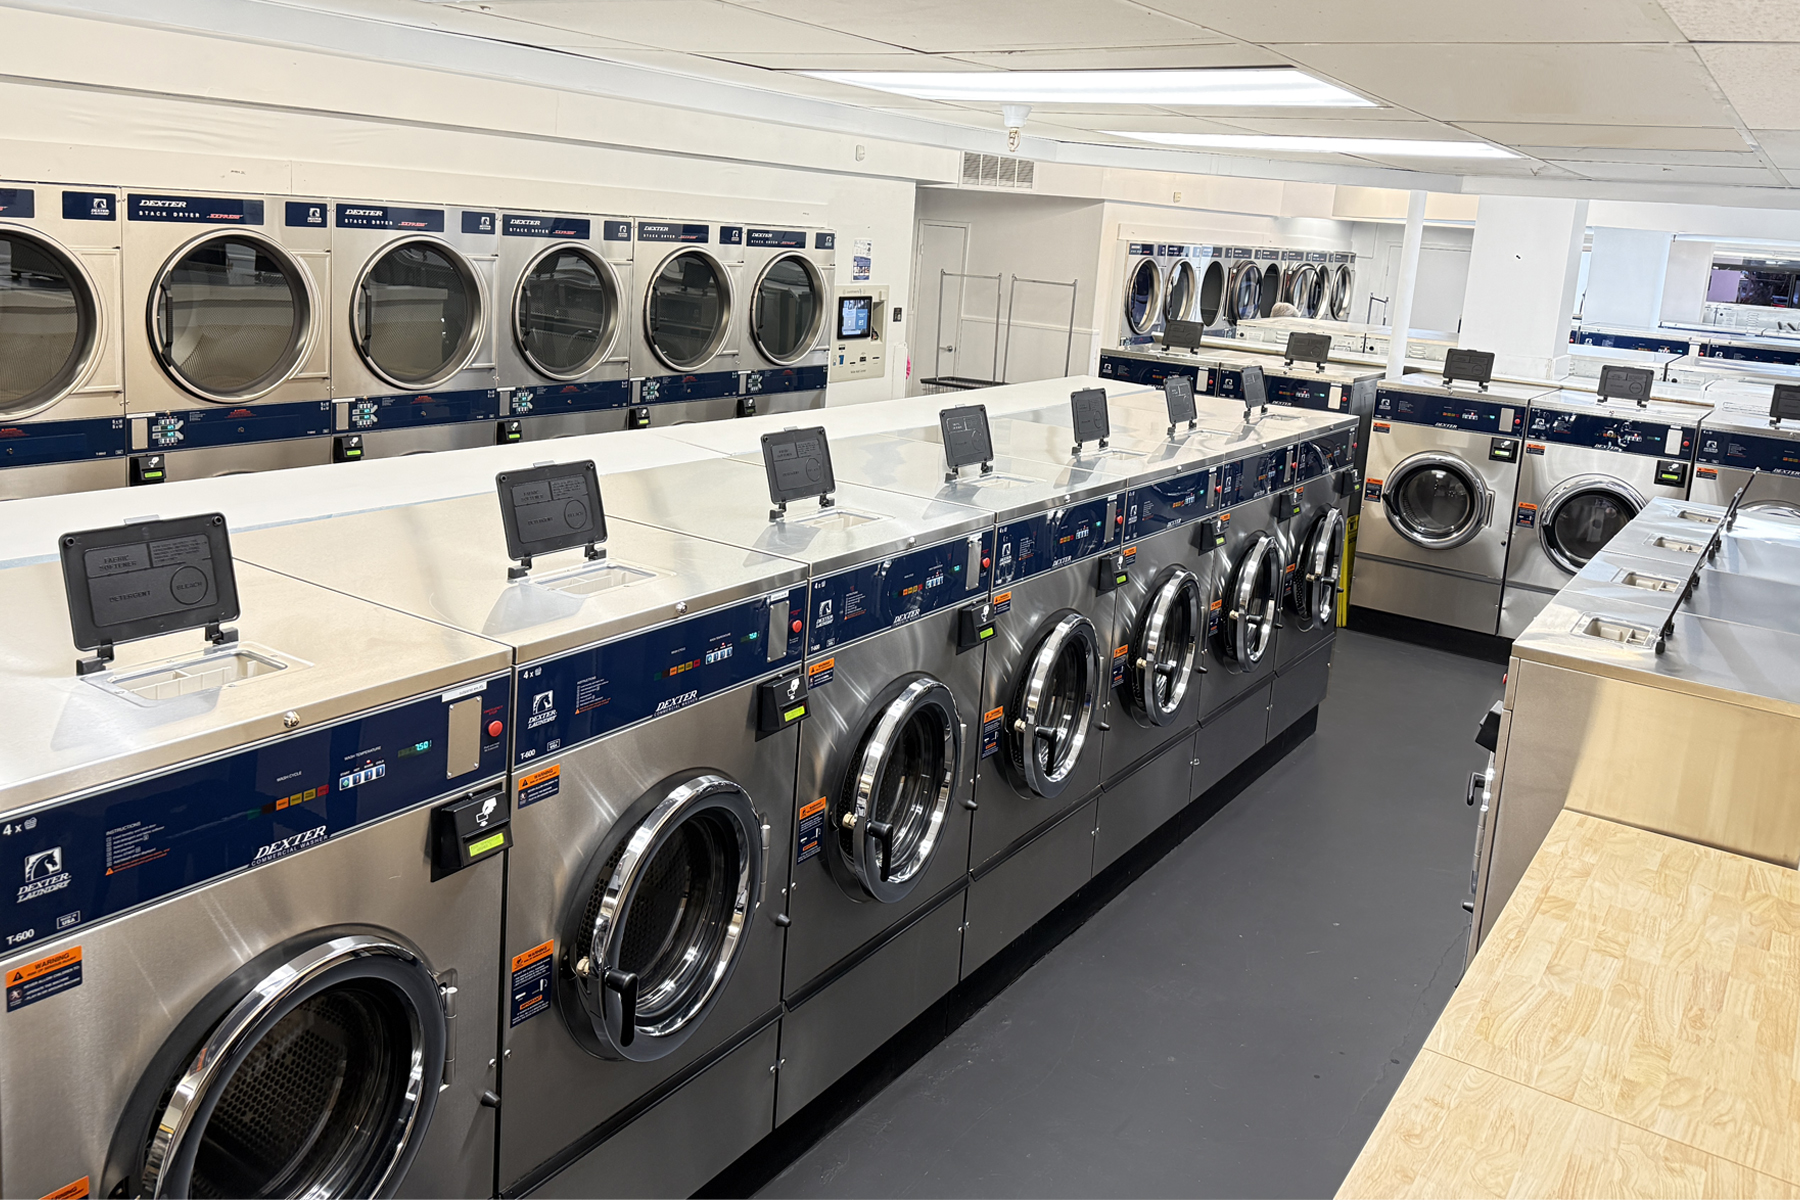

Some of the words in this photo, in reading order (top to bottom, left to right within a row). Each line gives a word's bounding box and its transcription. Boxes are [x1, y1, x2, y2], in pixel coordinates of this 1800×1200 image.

[139, 199, 187, 208] DEXTER
[345, 209, 383, 217] DEXTER
[109, 590, 151, 603] DETERGENT
[894, 608, 921, 623] DEXTER
[523, 668, 529, 679] 4
[655, 690, 698, 712] DEXTER
[528, 709, 557, 724] DEXTER
[520, 749, 536, 759] T-600
[3, 824, 12, 835] 4
[253, 825, 327, 860] DEXTER
[251, 846, 298, 867] COMMERCIAL
[300, 834, 328, 849] WASHER
[17, 872, 71, 896] DEXTER
[17, 879, 71, 903] LAUNDRY
[62, 917, 76, 926] USA
[6, 928, 35, 945] T-600
[34, 953, 70, 970] WARNING
